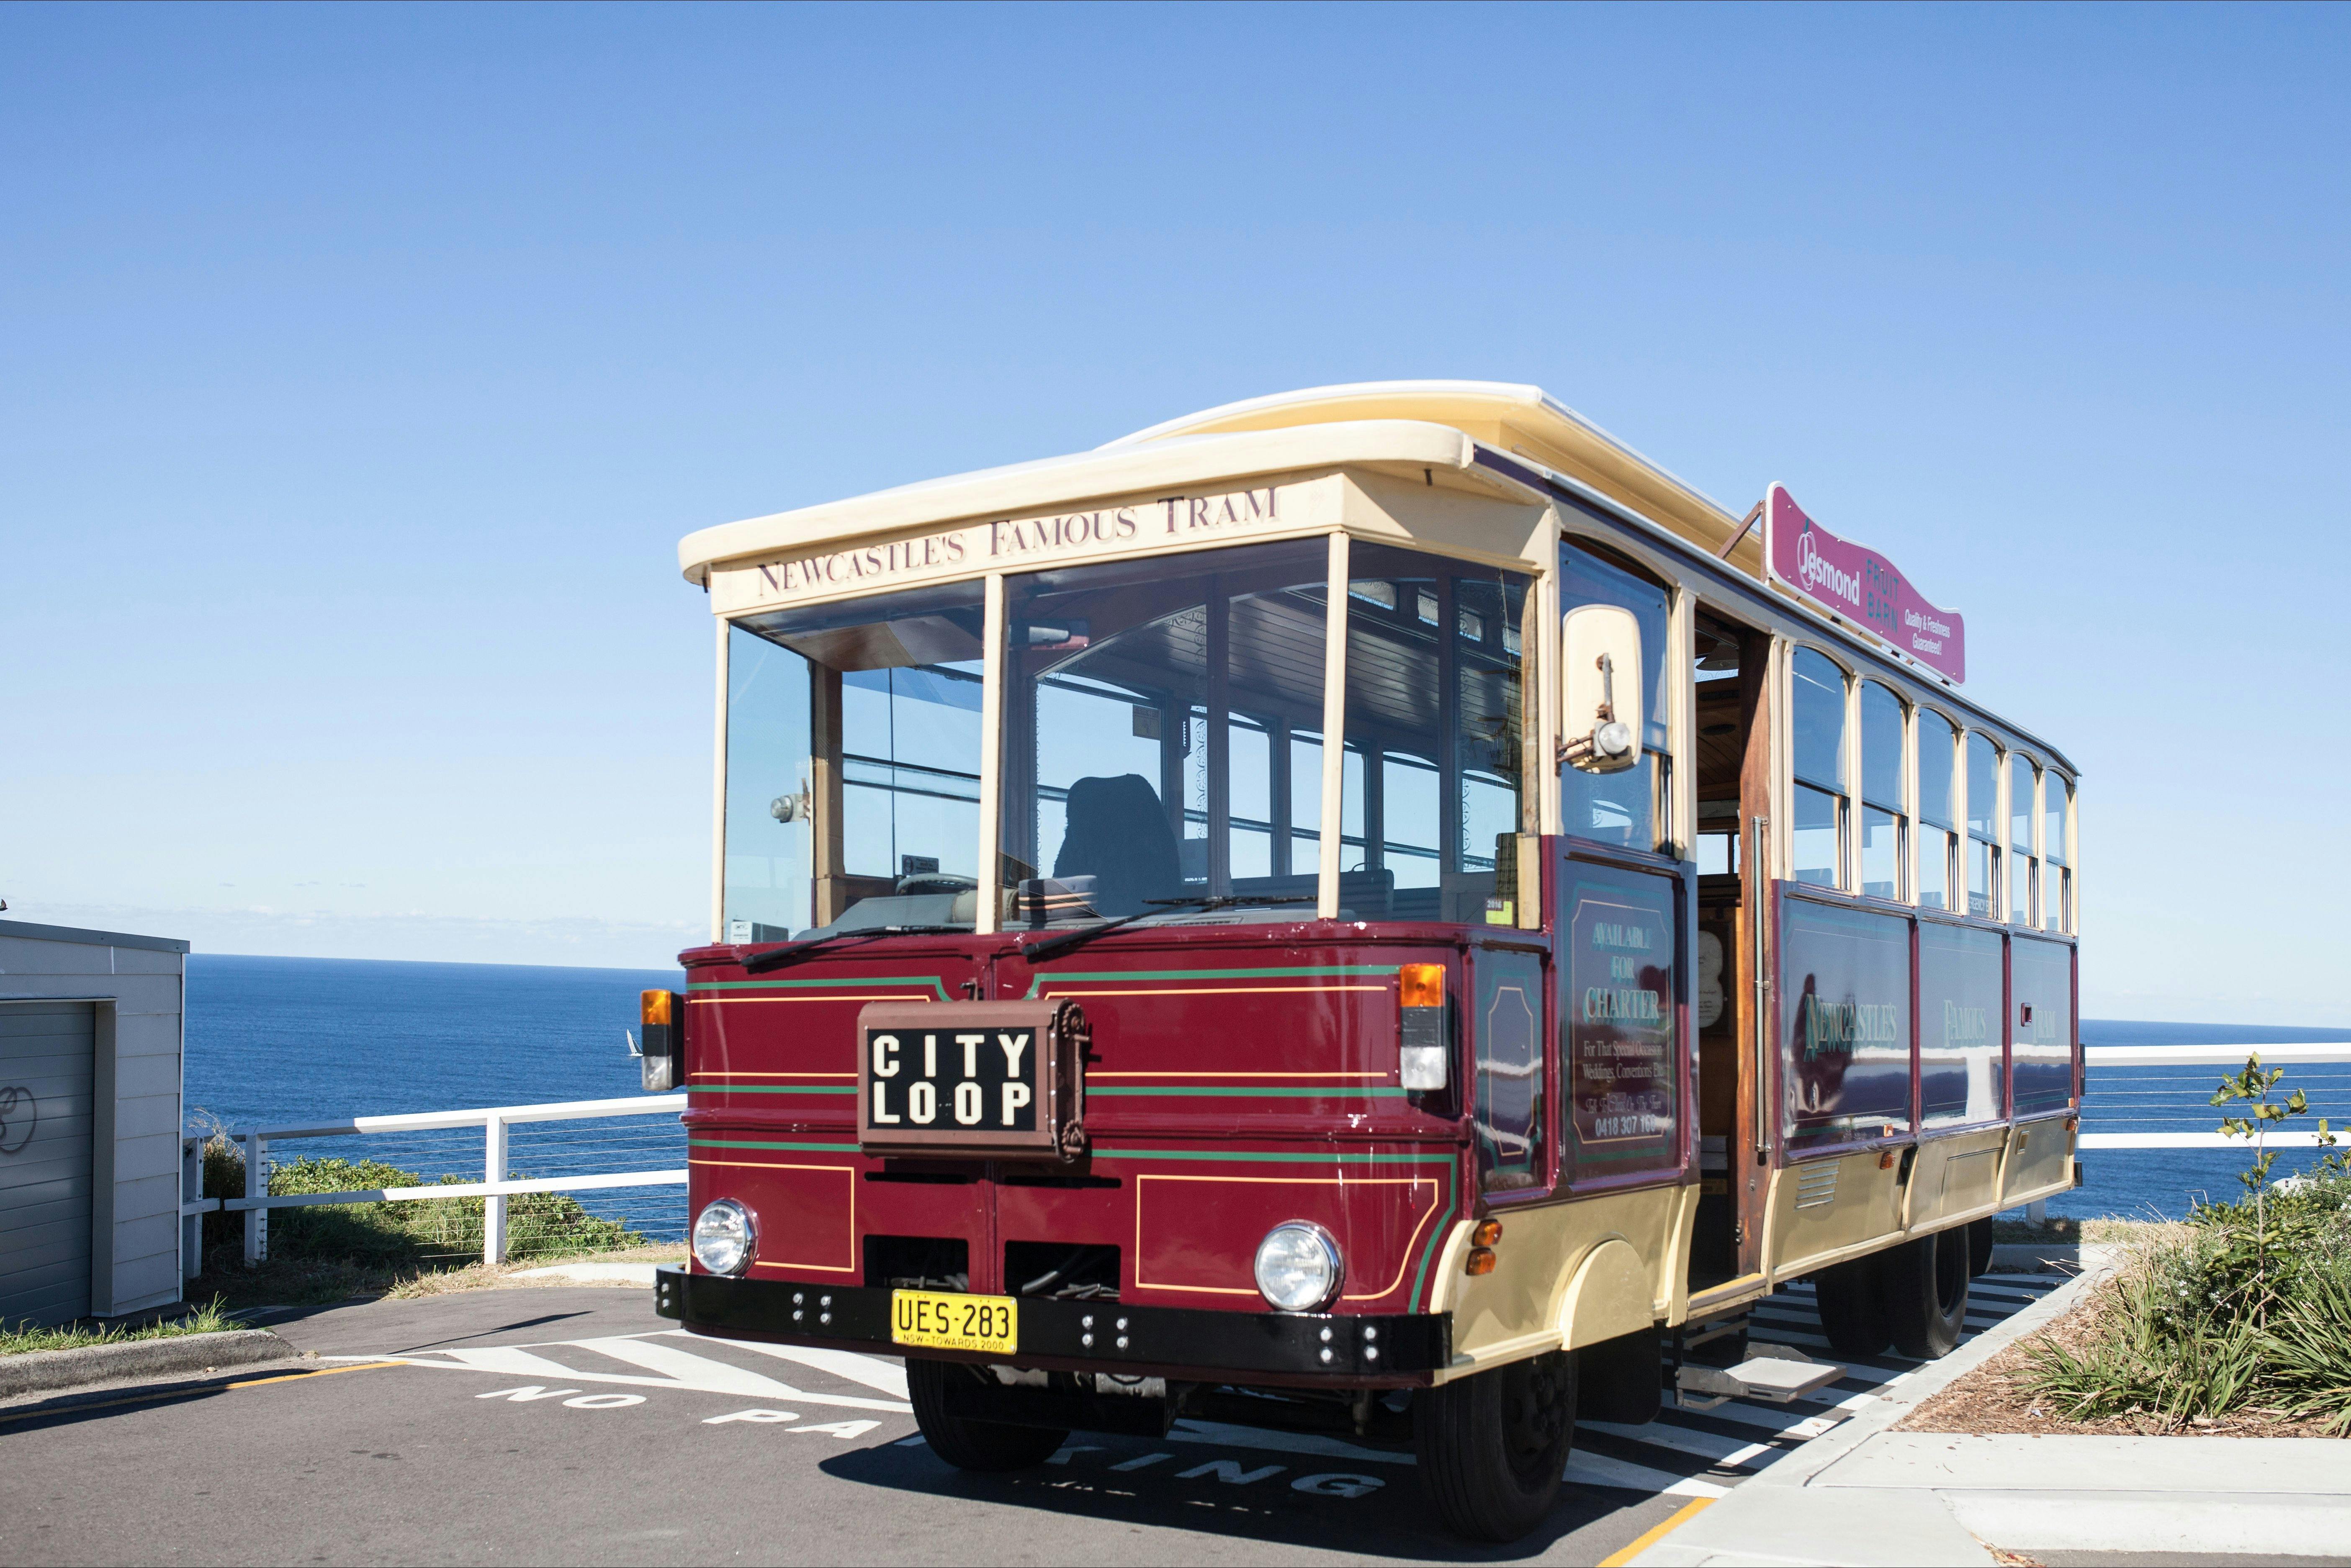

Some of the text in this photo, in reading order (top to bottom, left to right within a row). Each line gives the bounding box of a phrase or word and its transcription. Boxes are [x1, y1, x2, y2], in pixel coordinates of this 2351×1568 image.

[757, 487, 1277, 596] NEWCASTLE'S FAMOUS TRAM
[1801, 533, 1860, 607] Jesmond
[1866, 558, 1898, 603] FRUIT
[1867, 591, 1898, 633] BARN
[1905, 609, 1950, 638] Quality & Freshness
[1912, 632, 1942, 656] Guaranteed!
[1612, 956, 1634, 979] FOR
[1586, 987, 1660, 1019] CHARTER
[1944, 1000, 1986, 1047] FAMOUS
[873, 1034, 1029, 1077] CITY
[874, 1081, 1030, 1125] LOOP
[1595, 1117, 1619, 1137] 0418
[1620, 1116, 1638, 1135] 307
[981, 1340, 1004, 1350] 2000
[475, 1385, 647, 1409] NO
[701, 1409, 1386, 1498] PAING
